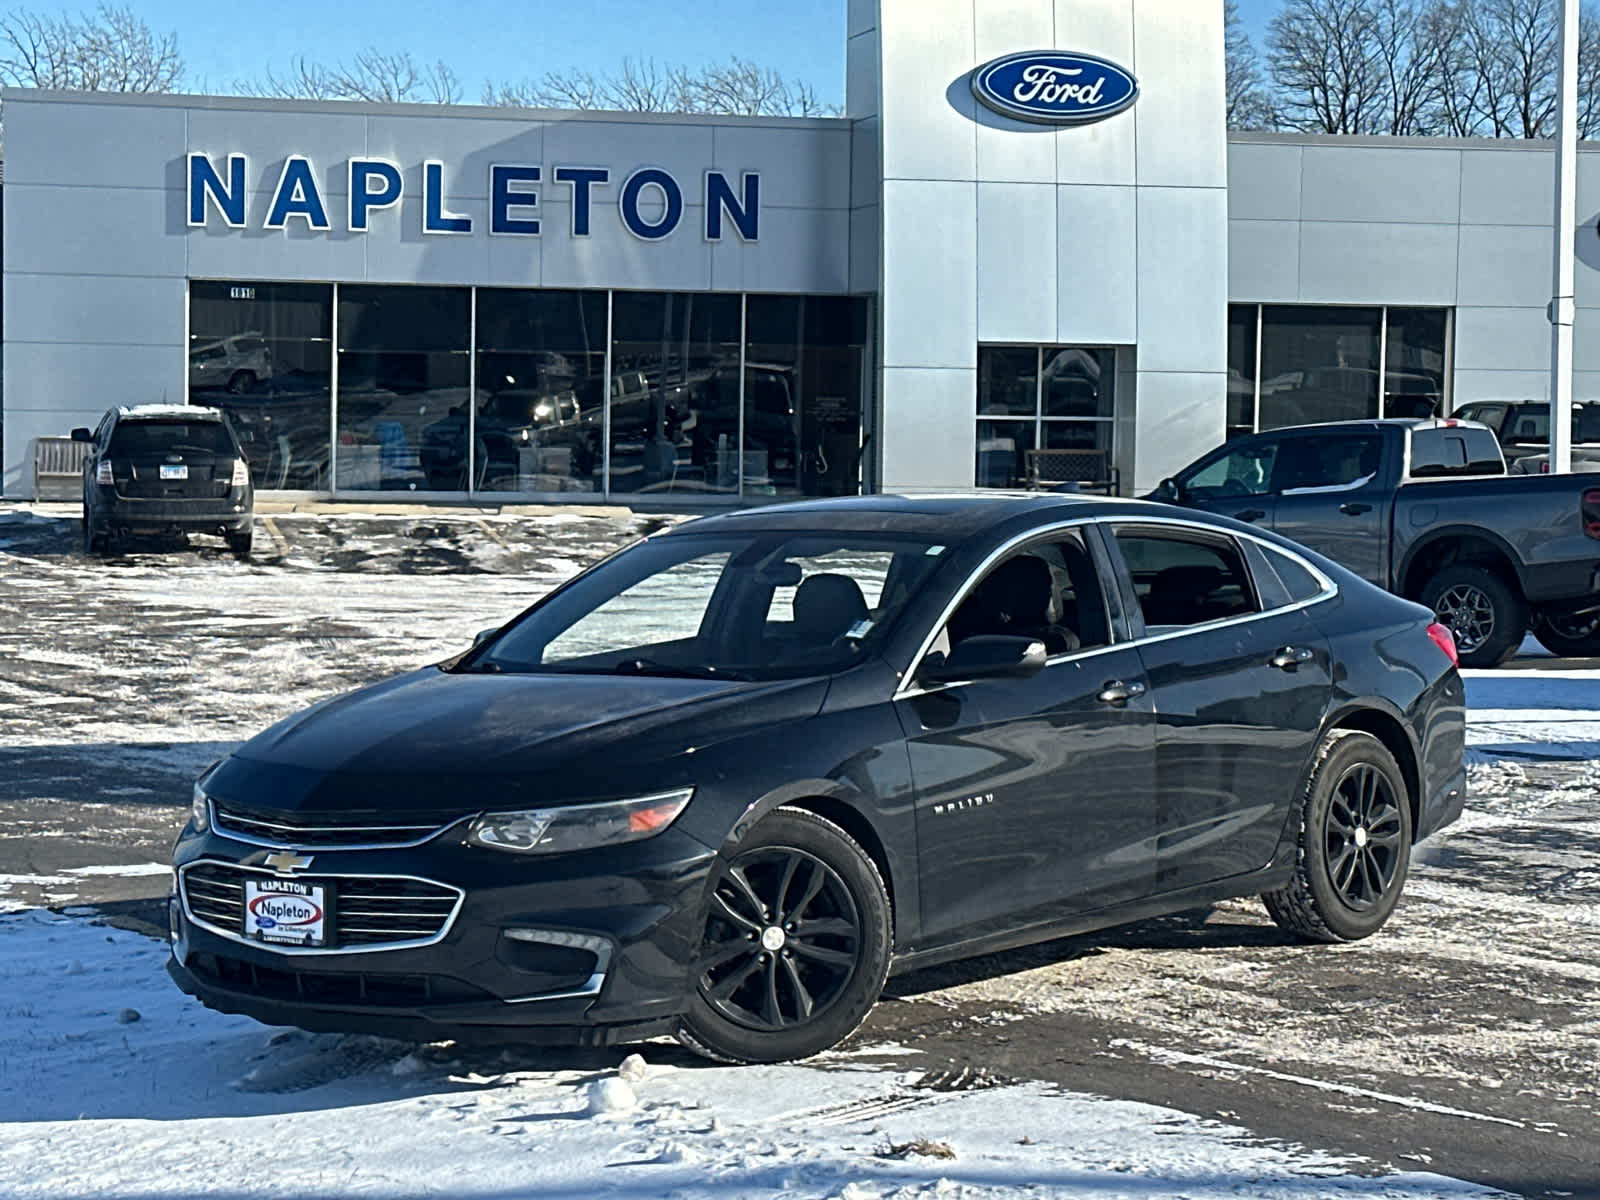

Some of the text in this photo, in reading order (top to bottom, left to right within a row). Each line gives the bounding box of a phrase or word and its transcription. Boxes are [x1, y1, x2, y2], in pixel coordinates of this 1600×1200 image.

[1013, 65, 1106, 105] Ford
[187, 152, 761, 242] NAPLETON
[934, 793, 994, 815] MALIBU
[261, 881, 307, 895] NAPLETON
[261, 900, 311, 920] Napleton
